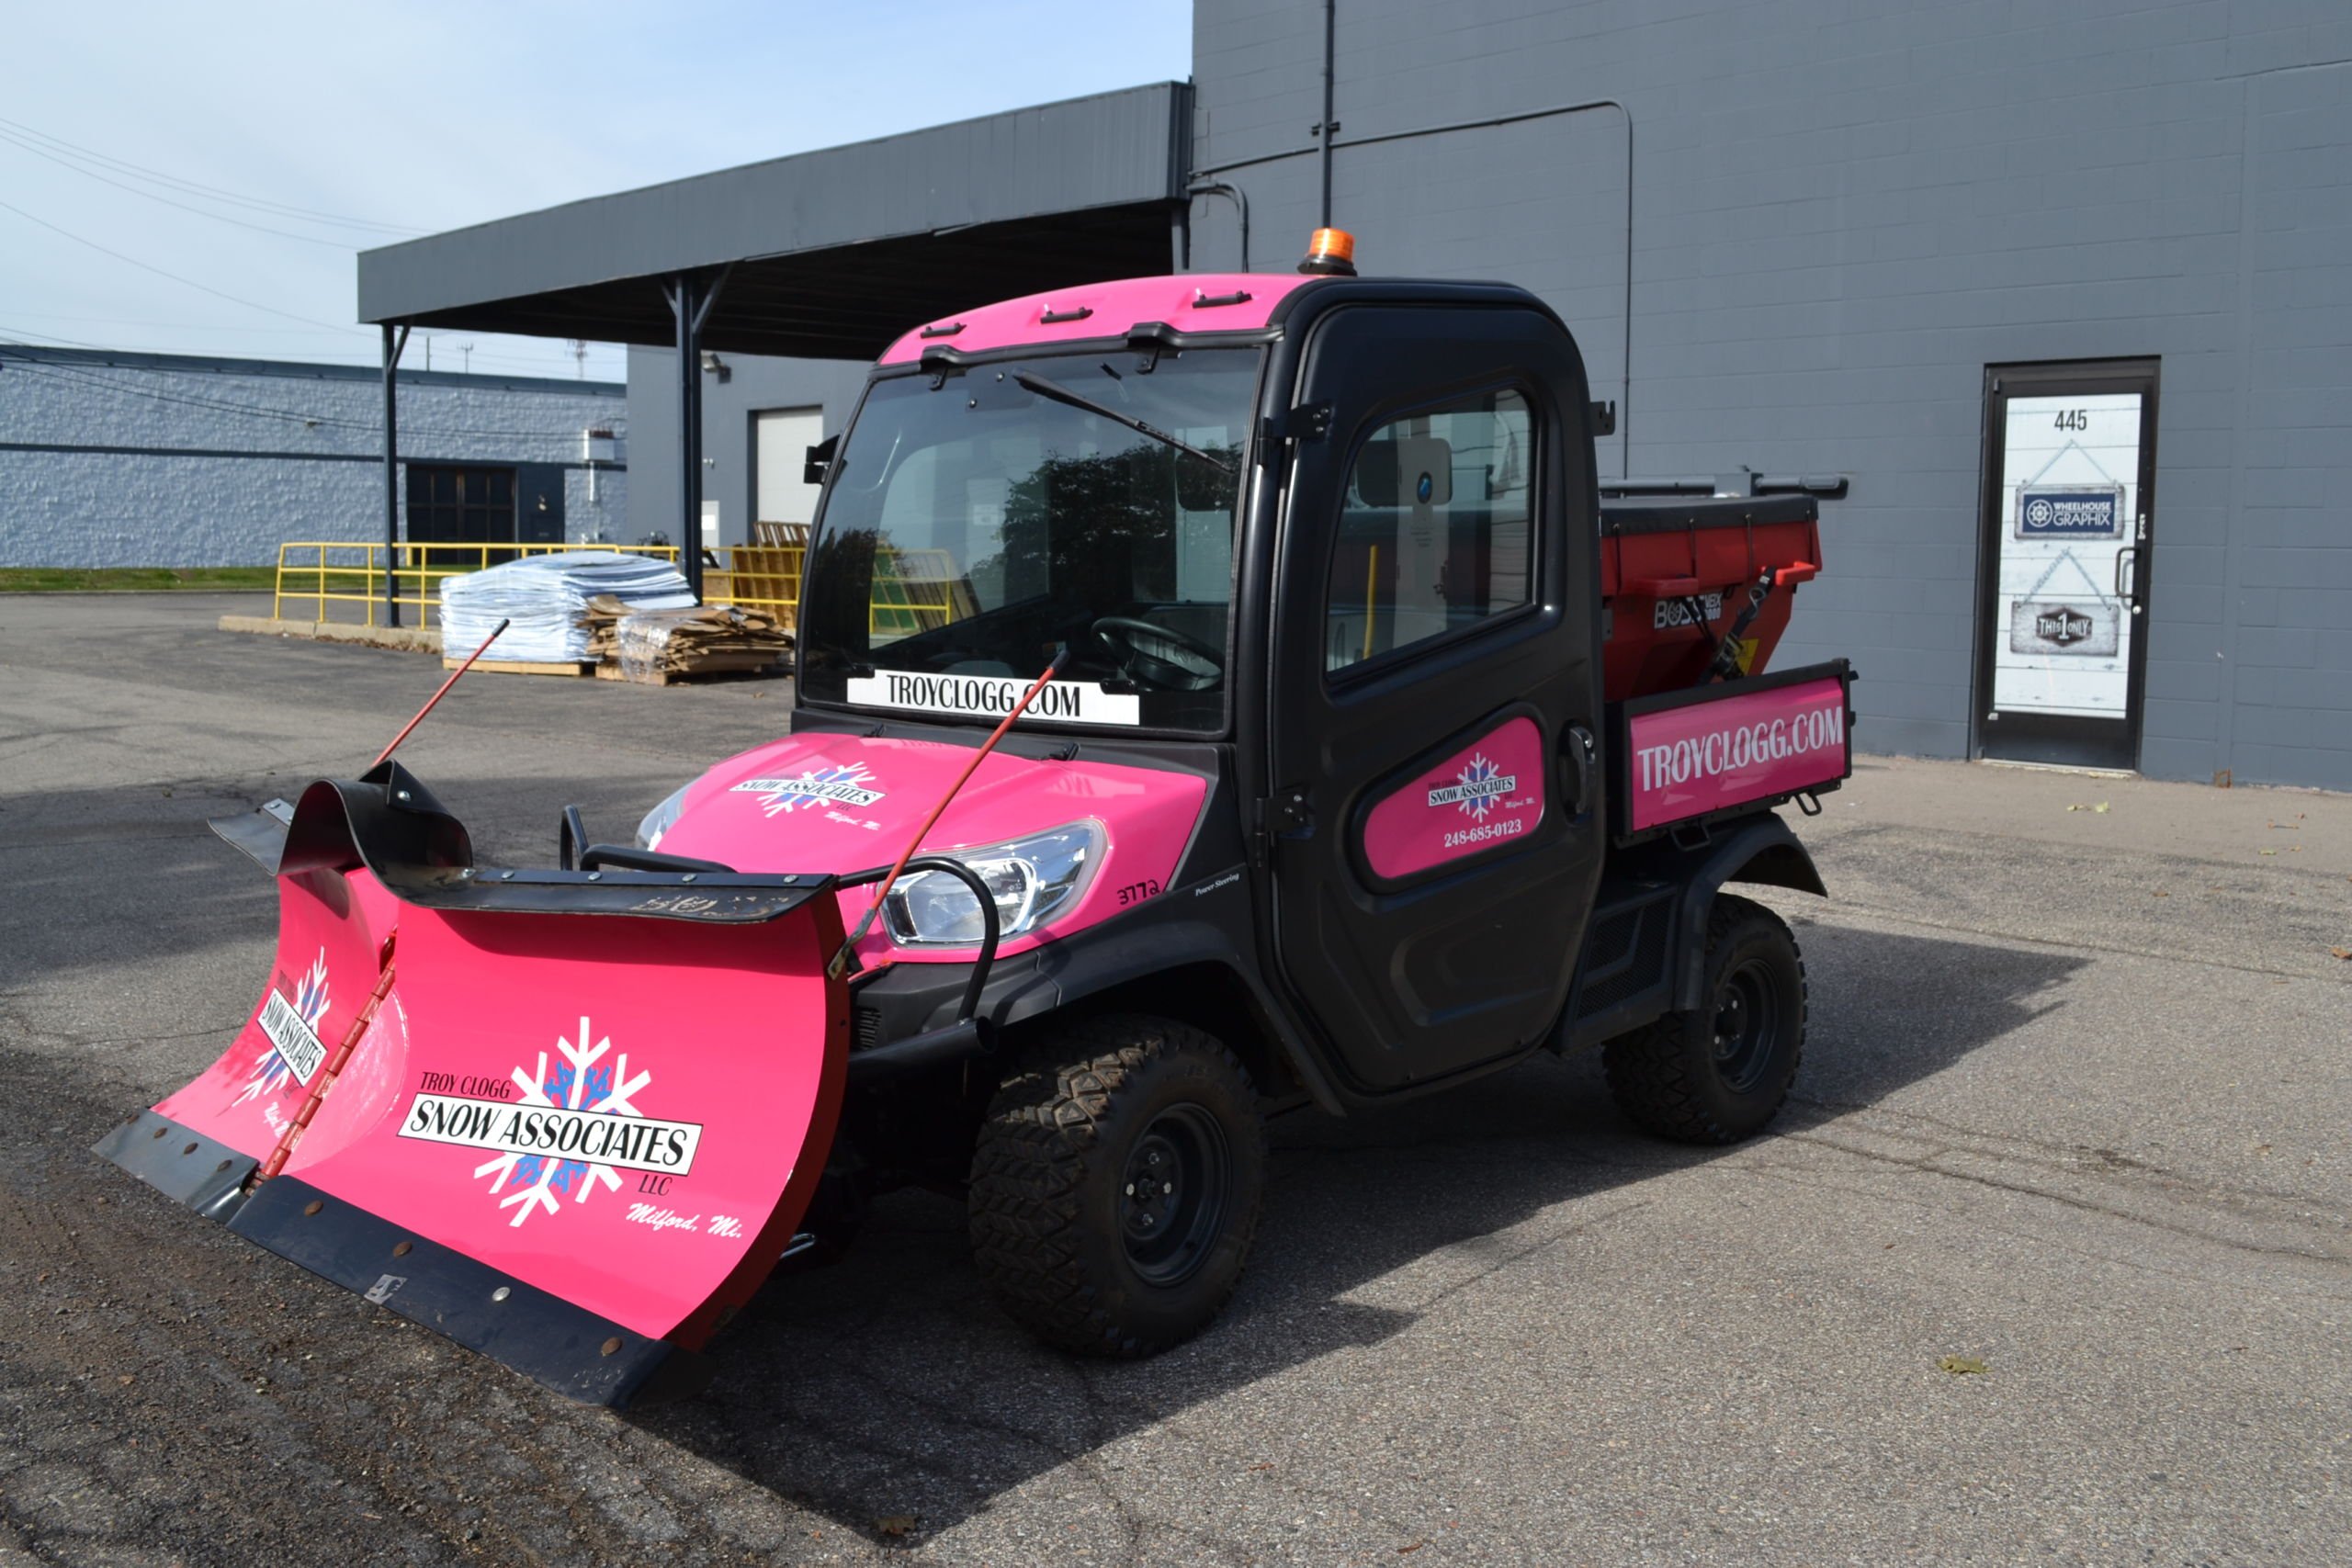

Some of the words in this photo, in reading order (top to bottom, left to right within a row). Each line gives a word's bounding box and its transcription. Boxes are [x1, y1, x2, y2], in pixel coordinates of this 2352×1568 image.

[2054, 410, 2087, 432] 445
[2053, 502, 2111, 511] WHEELHOUSE
[2053, 513, 2110, 526] GRAPHIX
[2039, 617, 2061, 635] THIS
[2058, 612, 2069, 640] 1
[2067, 618, 2089, 636] ONLY
[886, 674, 1080, 717] TROYCLOGGCOM
[1637, 705, 1843, 792] TROYCLOGG.COM
[736, 780, 778, 791] SNOW
[781, 781, 876, 804] ASSOCIATES
[1430, 788, 1458, 805] SNOW
[1460, 778, 1513, 798] ASSOCIATES
[1444, 818, 1521, 848] 248-685-0123
[1117, 879, 1160, 905] 3772
[262, 992, 282, 1032] SNOW
[277, 1014, 322, 1078] ASSOCIATES
[419, 1071, 458, 1093] TROY
[460, 1076, 512, 1100] CLOGG
[410, 1100, 502, 1142] SNOW
[498, 1111, 689, 1167] ASSOCIATES
[639, 1174, 673, 1196] LLC
[626, 1202, 698, 1232] Milford,
[707, 1213, 742, 1239] Mi.
